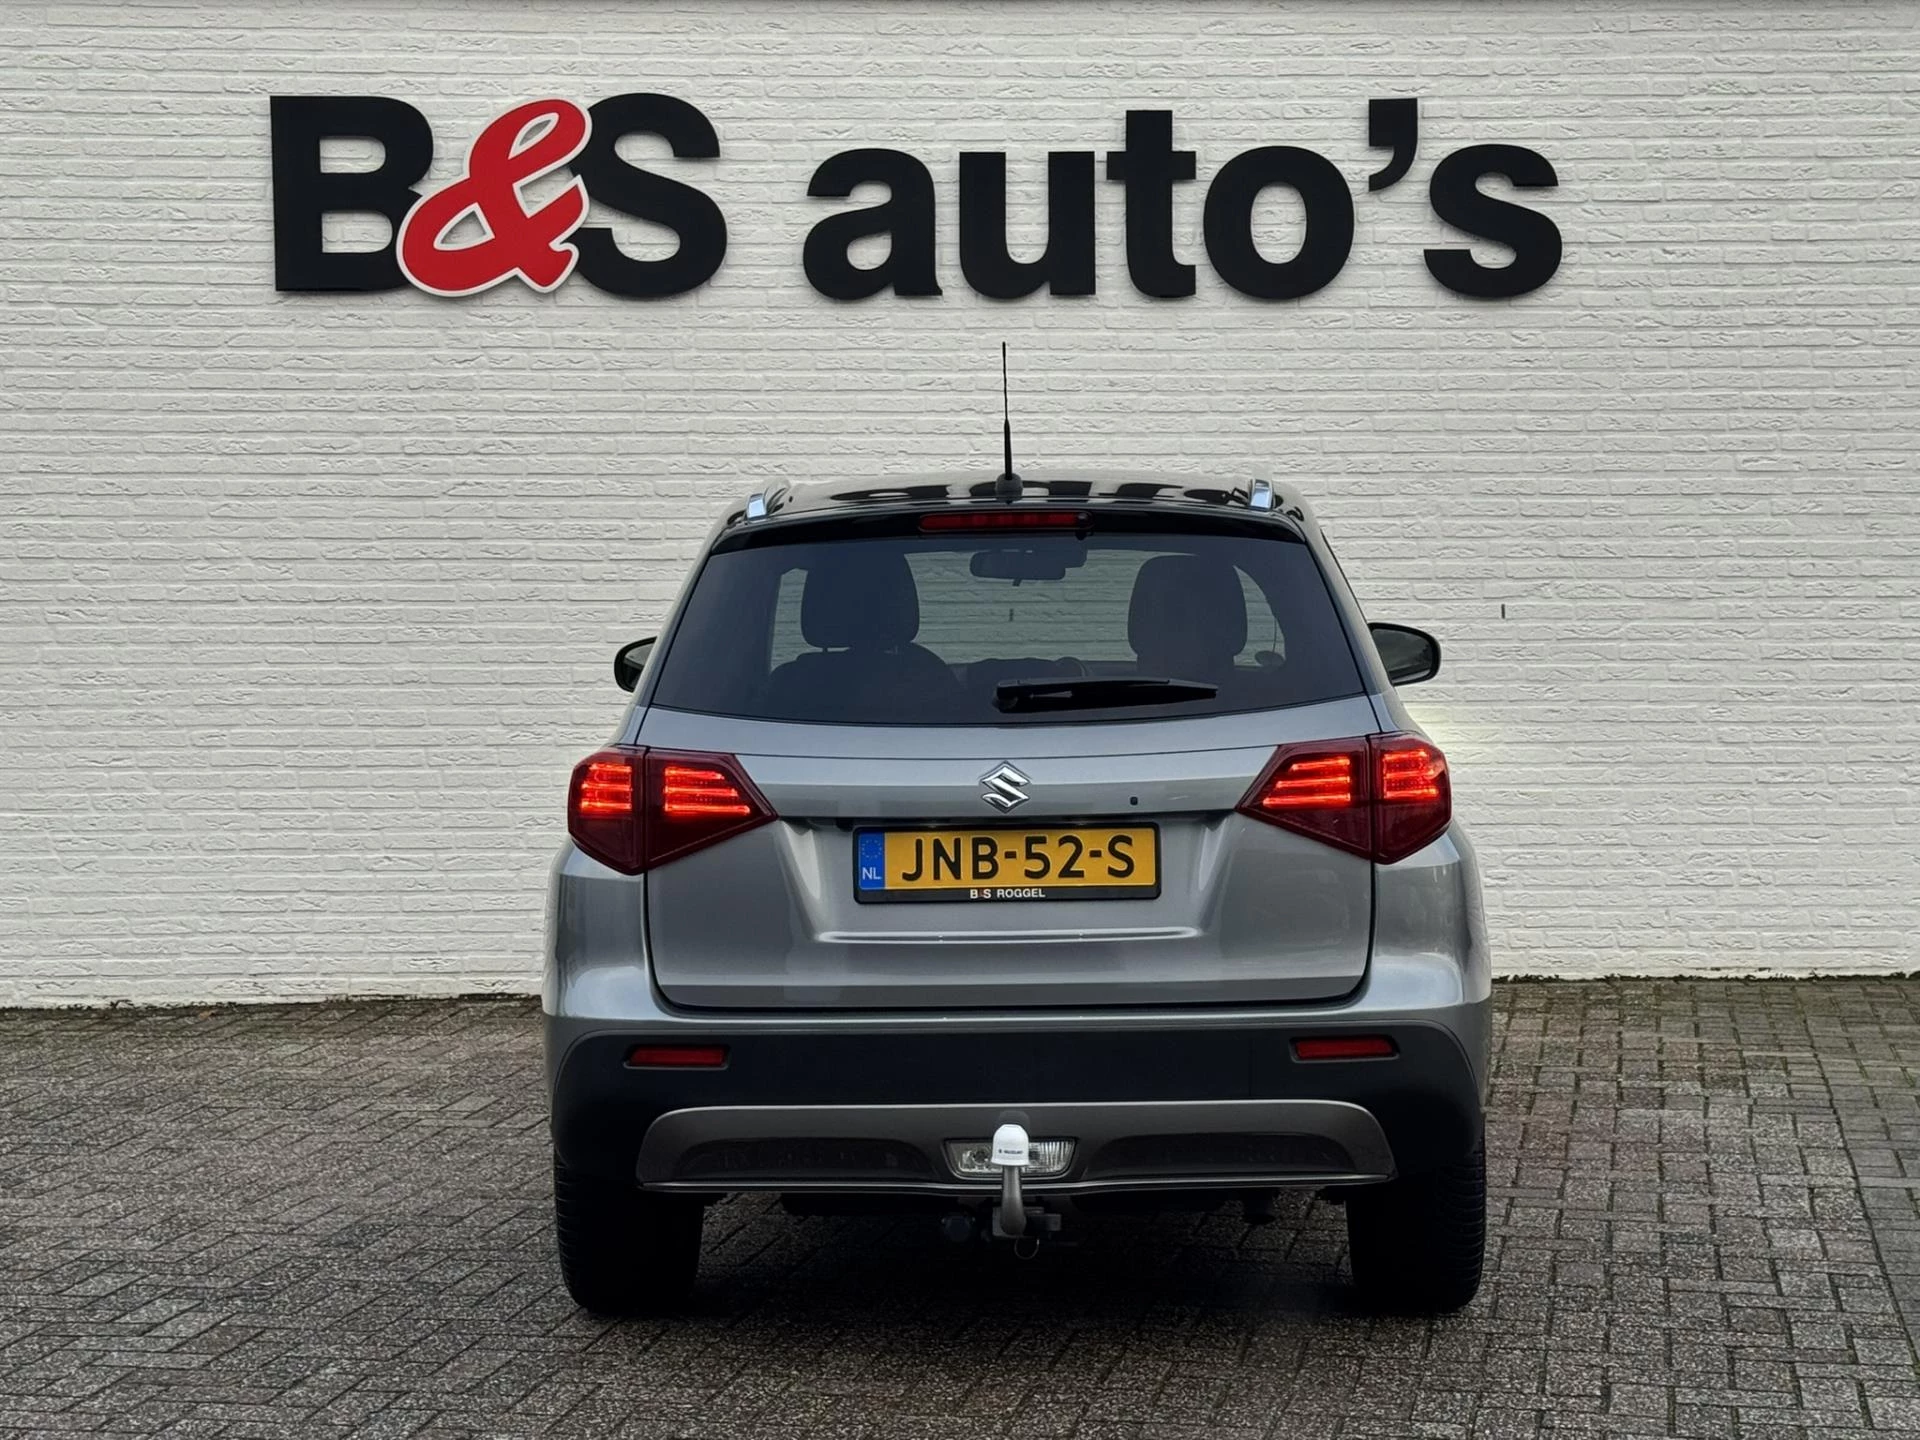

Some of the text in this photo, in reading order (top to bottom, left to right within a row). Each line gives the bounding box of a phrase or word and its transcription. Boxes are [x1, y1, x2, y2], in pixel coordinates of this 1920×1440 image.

[270, 93, 1563, 300] B&S auto's
[902, 834, 1135, 881] JNB-52-S
[862, 867, 882, 881] NL
[996, 887, 1046, 898] ROGGEL
